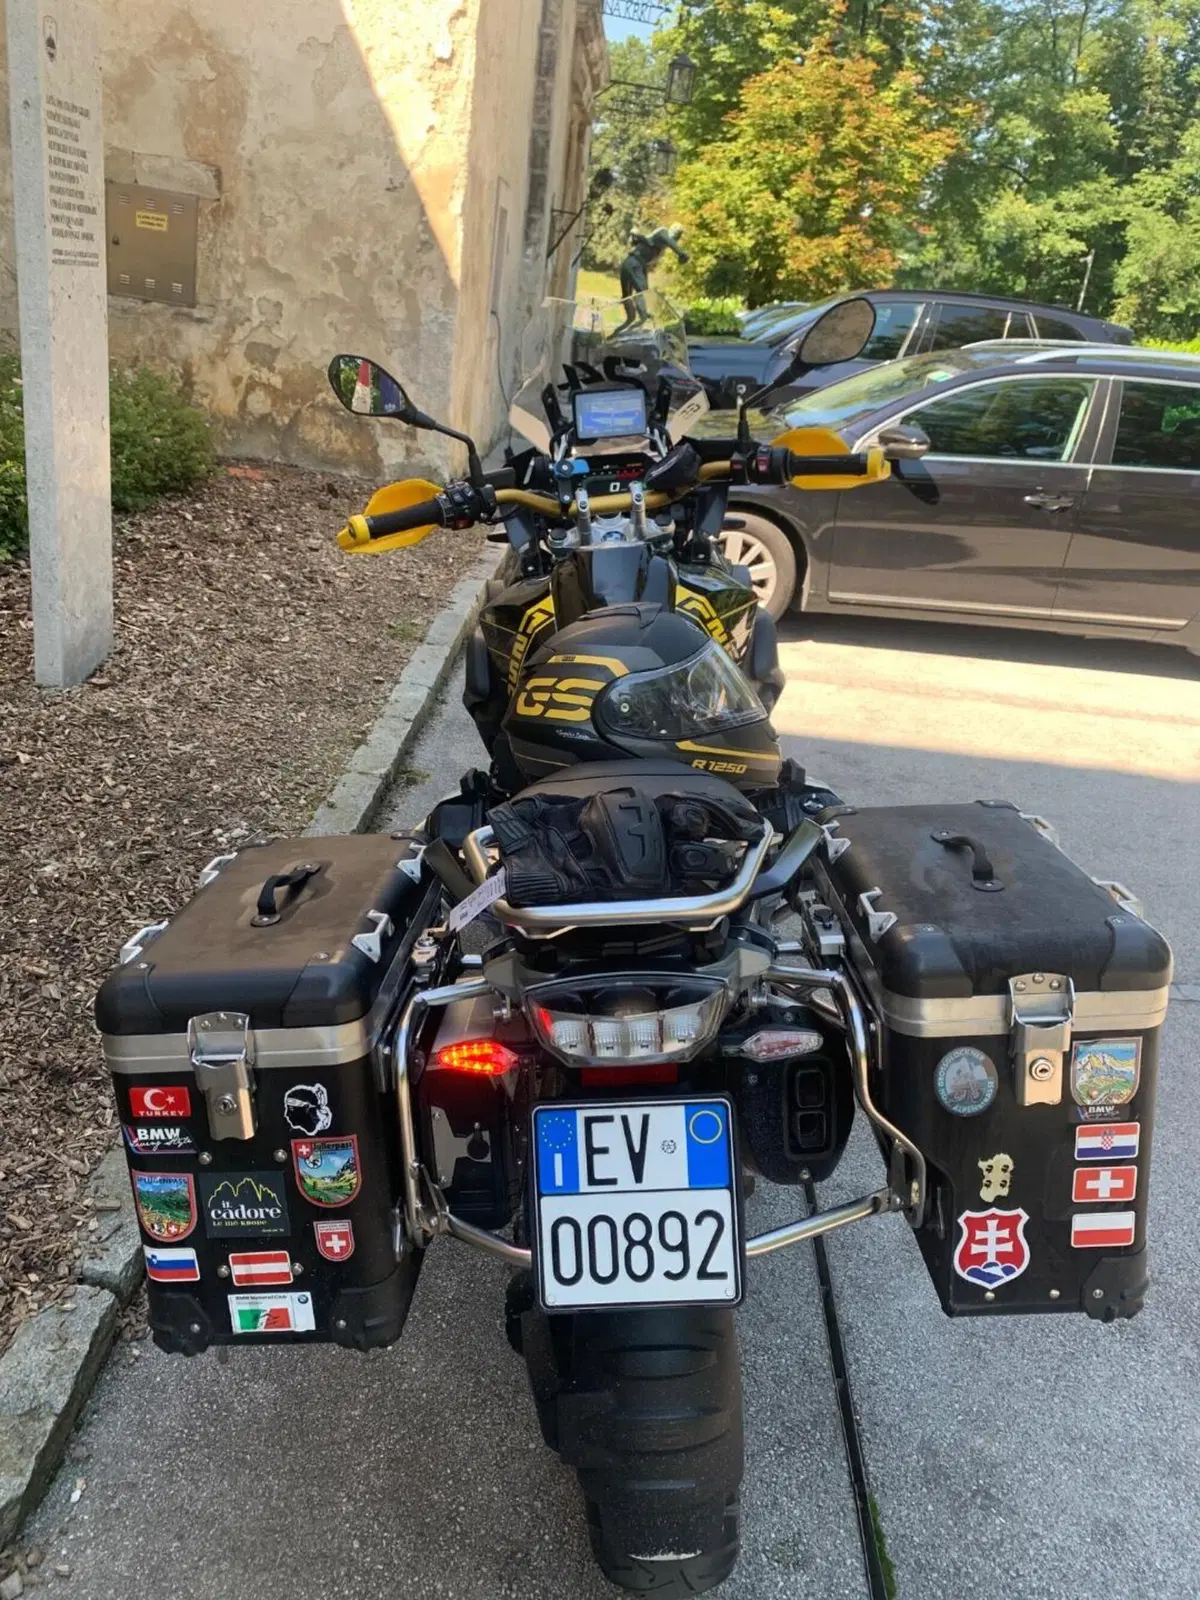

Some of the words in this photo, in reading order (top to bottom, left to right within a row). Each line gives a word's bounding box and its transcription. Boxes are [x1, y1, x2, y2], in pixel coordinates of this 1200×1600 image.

[516, 677, 607, 722] GS
[691, 759, 707, 770] R
[708, 760, 748, 775] 1250
[138, 1109, 185, 1117] TURKEY
[1088, 1105, 1115, 1113] BMW
[136, 1127, 181, 1141] BMW
[583, 1113, 651, 1187] EV
[553, 1152, 564, 1187] I
[210, 1204, 282, 1220] cadore
[550, 1209, 729, 1287] 00892
